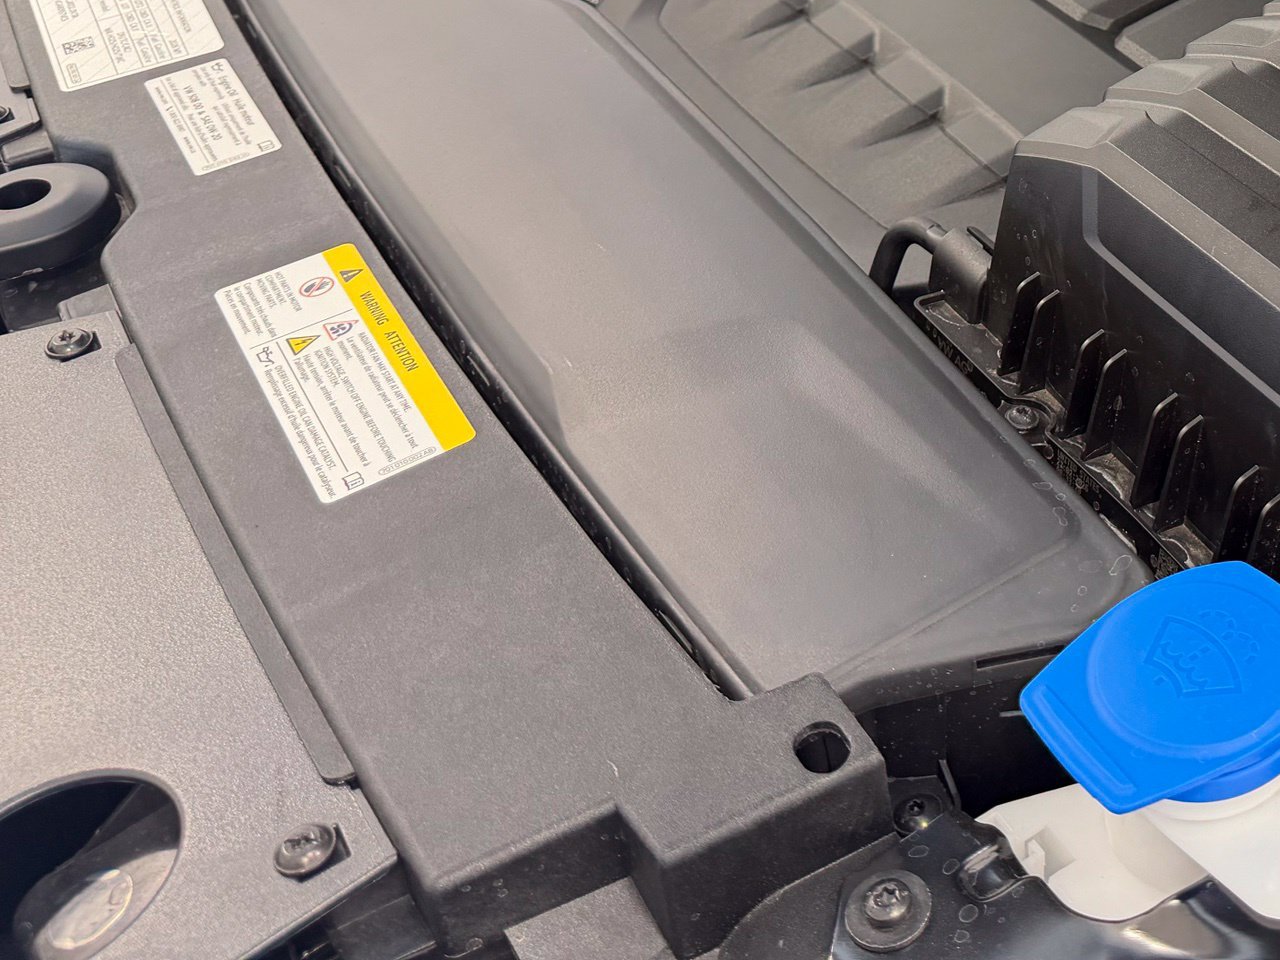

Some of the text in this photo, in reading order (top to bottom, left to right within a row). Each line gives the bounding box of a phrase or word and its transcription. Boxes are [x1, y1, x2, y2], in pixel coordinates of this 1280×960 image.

[359, 290, 418, 371] WARNING ATTENTION
[357, 331, 376, 353] RADIATOR
[301, 353, 316, 368] Haute
[313, 349, 330, 369] IGNITION
[349, 341, 369, 365] ventilateur
[370, 351, 381, 362] FAN
[363, 364, 373, 372] de
[375, 360, 387, 371] MAY
[273, 364, 294, 392] OVERFILLED
[366, 370, 385, 392] radiateur
[381, 370, 395, 384] START
[287, 390, 303, 409] ENGINE
[377, 390, 391, 403] peut
[393, 389, 405, 400] ANY
[322, 345, 335, 357] HIGH
[340, 375, 356, 394] SWITCH
[349, 392, 361, 403] OFF
[355, 401, 371, 419] ENGINE
[364, 418, 381, 438] BEFORE
[375, 436, 396, 462] TOUCHING
[261, 368, 285, 398] Remplissage
[293, 428, 315, 455] dangereux
[307, 453, 319, 467] pour
[296, 407, 307, 417] OIL
[331, 405, 346, 423] moteur
[301, 415, 313, 427] CAN
[306, 425, 324, 447] DAMAGE
[340, 422, 354, 437] avant
[347, 434, 359, 444] de
[406, 436, 418, 448] tout
[352, 442, 369, 463] toucher
